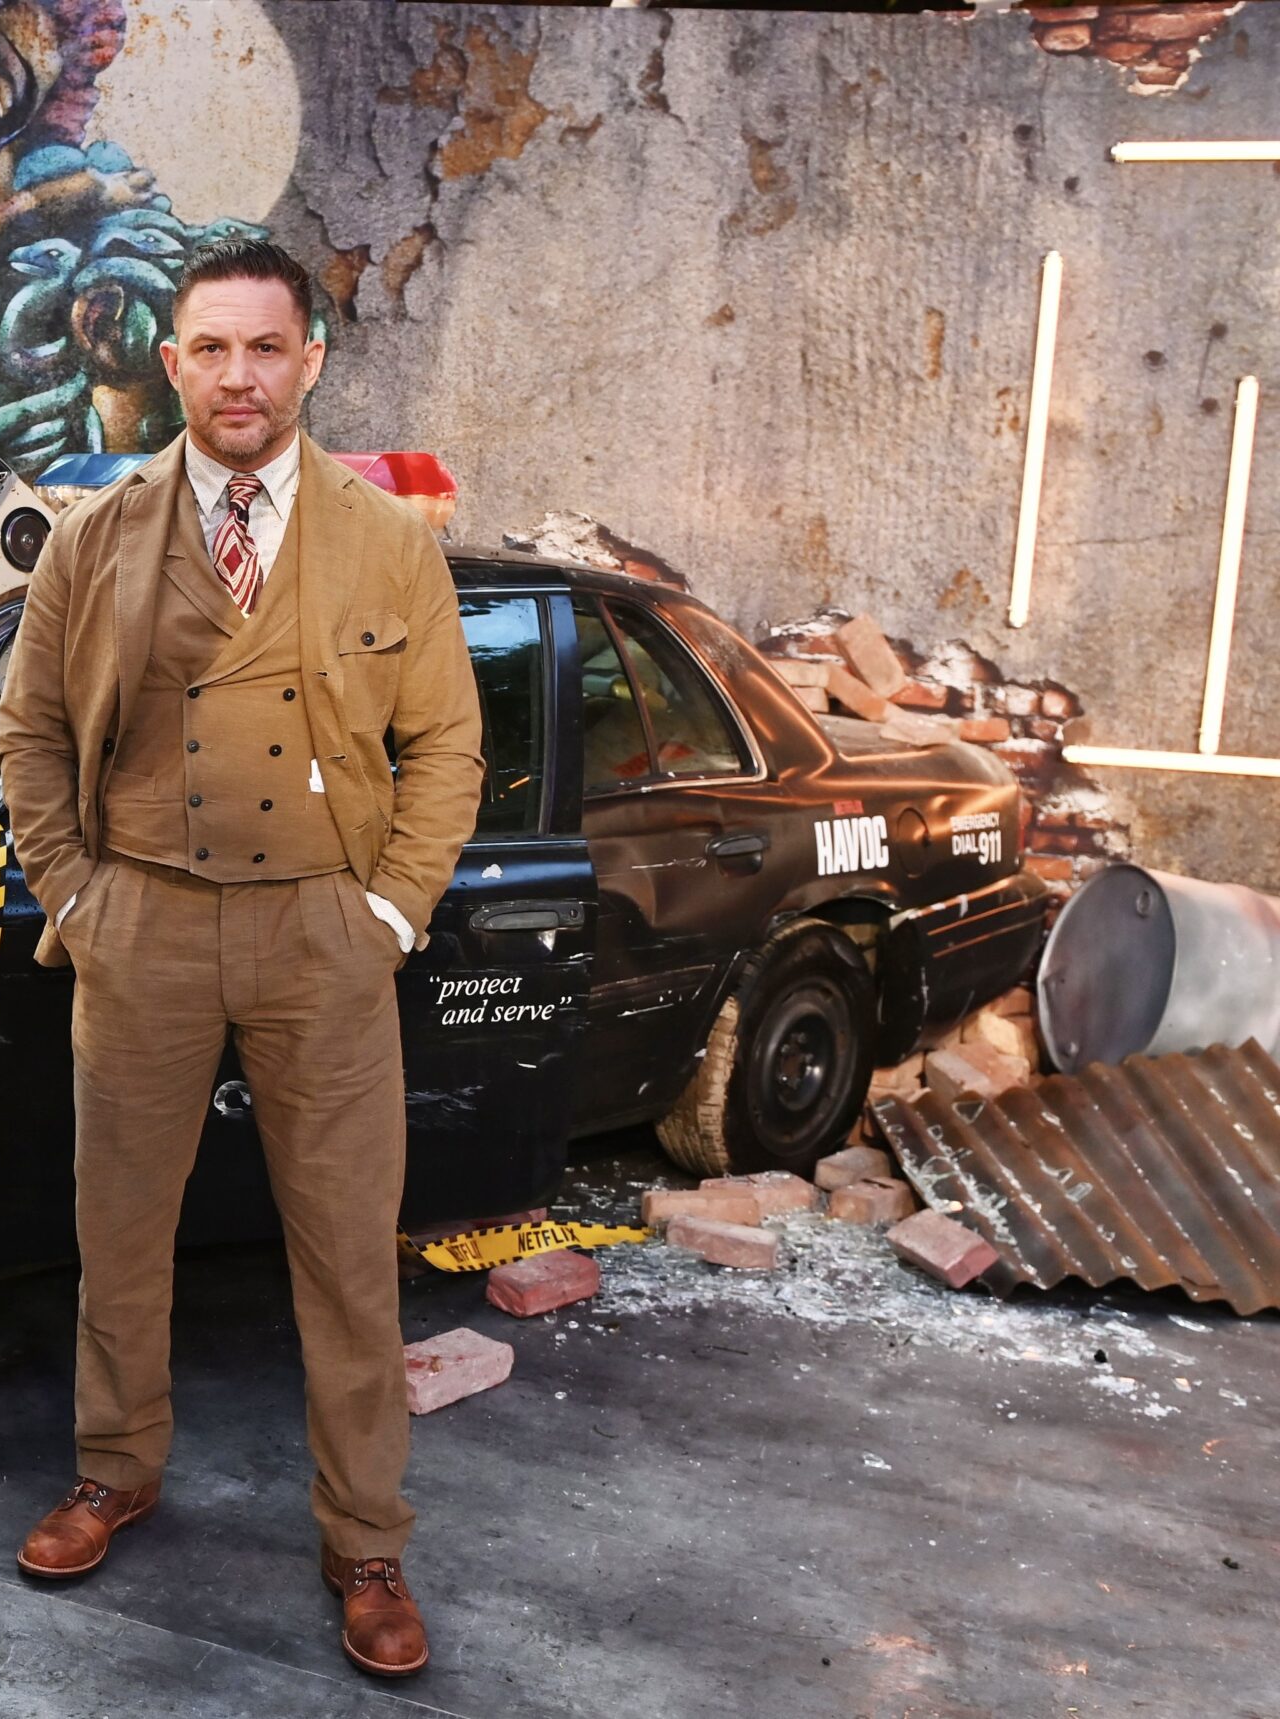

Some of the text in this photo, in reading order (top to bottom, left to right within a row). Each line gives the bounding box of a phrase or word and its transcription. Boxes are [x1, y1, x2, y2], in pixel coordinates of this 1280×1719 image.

[814, 815, 889, 875] HAVOC
[952, 830, 1001, 865] DIAL 911
[441, 999, 488, 1025] and
[517, 1227, 581, 1254] NETFLIX
